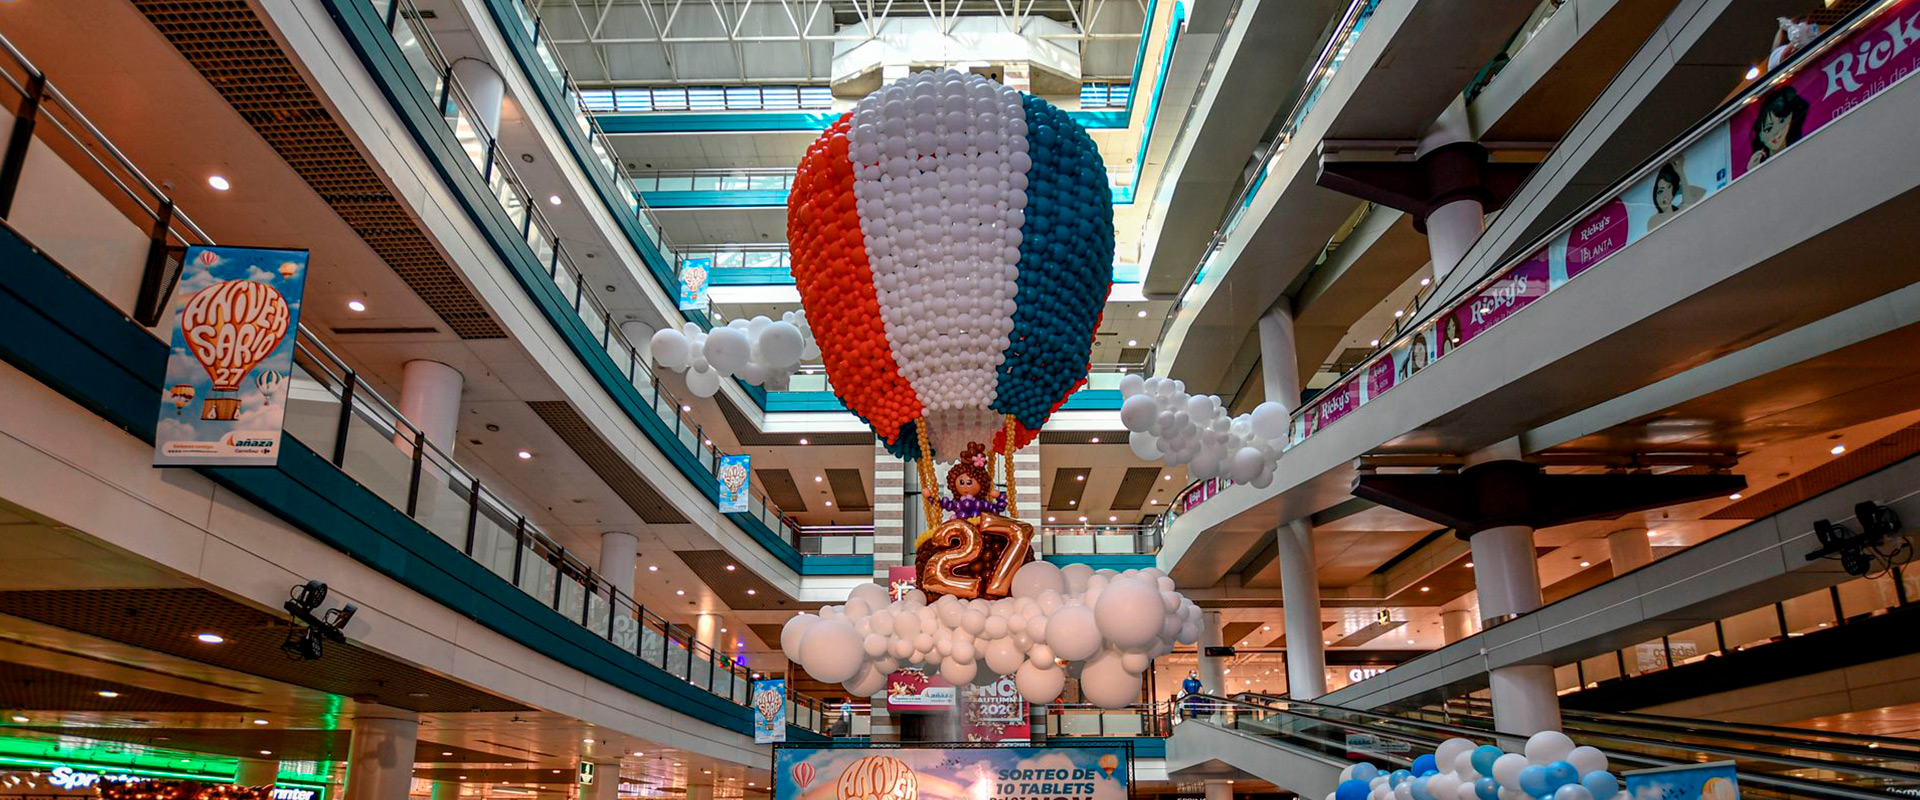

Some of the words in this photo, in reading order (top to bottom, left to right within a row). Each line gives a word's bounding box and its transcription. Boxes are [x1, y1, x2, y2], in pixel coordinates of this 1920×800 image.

[1832, 98, 1858, 119] más
[1863, 77, 1885, 101] allá
[1890, 67, 1907, 83] de
[1581, 216, 1610, 241] Ricky's
[184, 281, 288, 337] ANIVER
[1470, 274, 1528, 326] Ricky's
[190, 323, 276, 368] SARIO
[215, 368, 245, 386] 27
[1321, 391, 1350, 420] Ricky's
[235, 437, 273, 447] añaza
[923, 512, 1034, 598] 27
[996, 783, 1015, 795] 10
[1019, 783, 1095, 795] TABLETS
[998, 768, 1069, 781] SORTEO
[1071, 768, 1096, 781] DE
